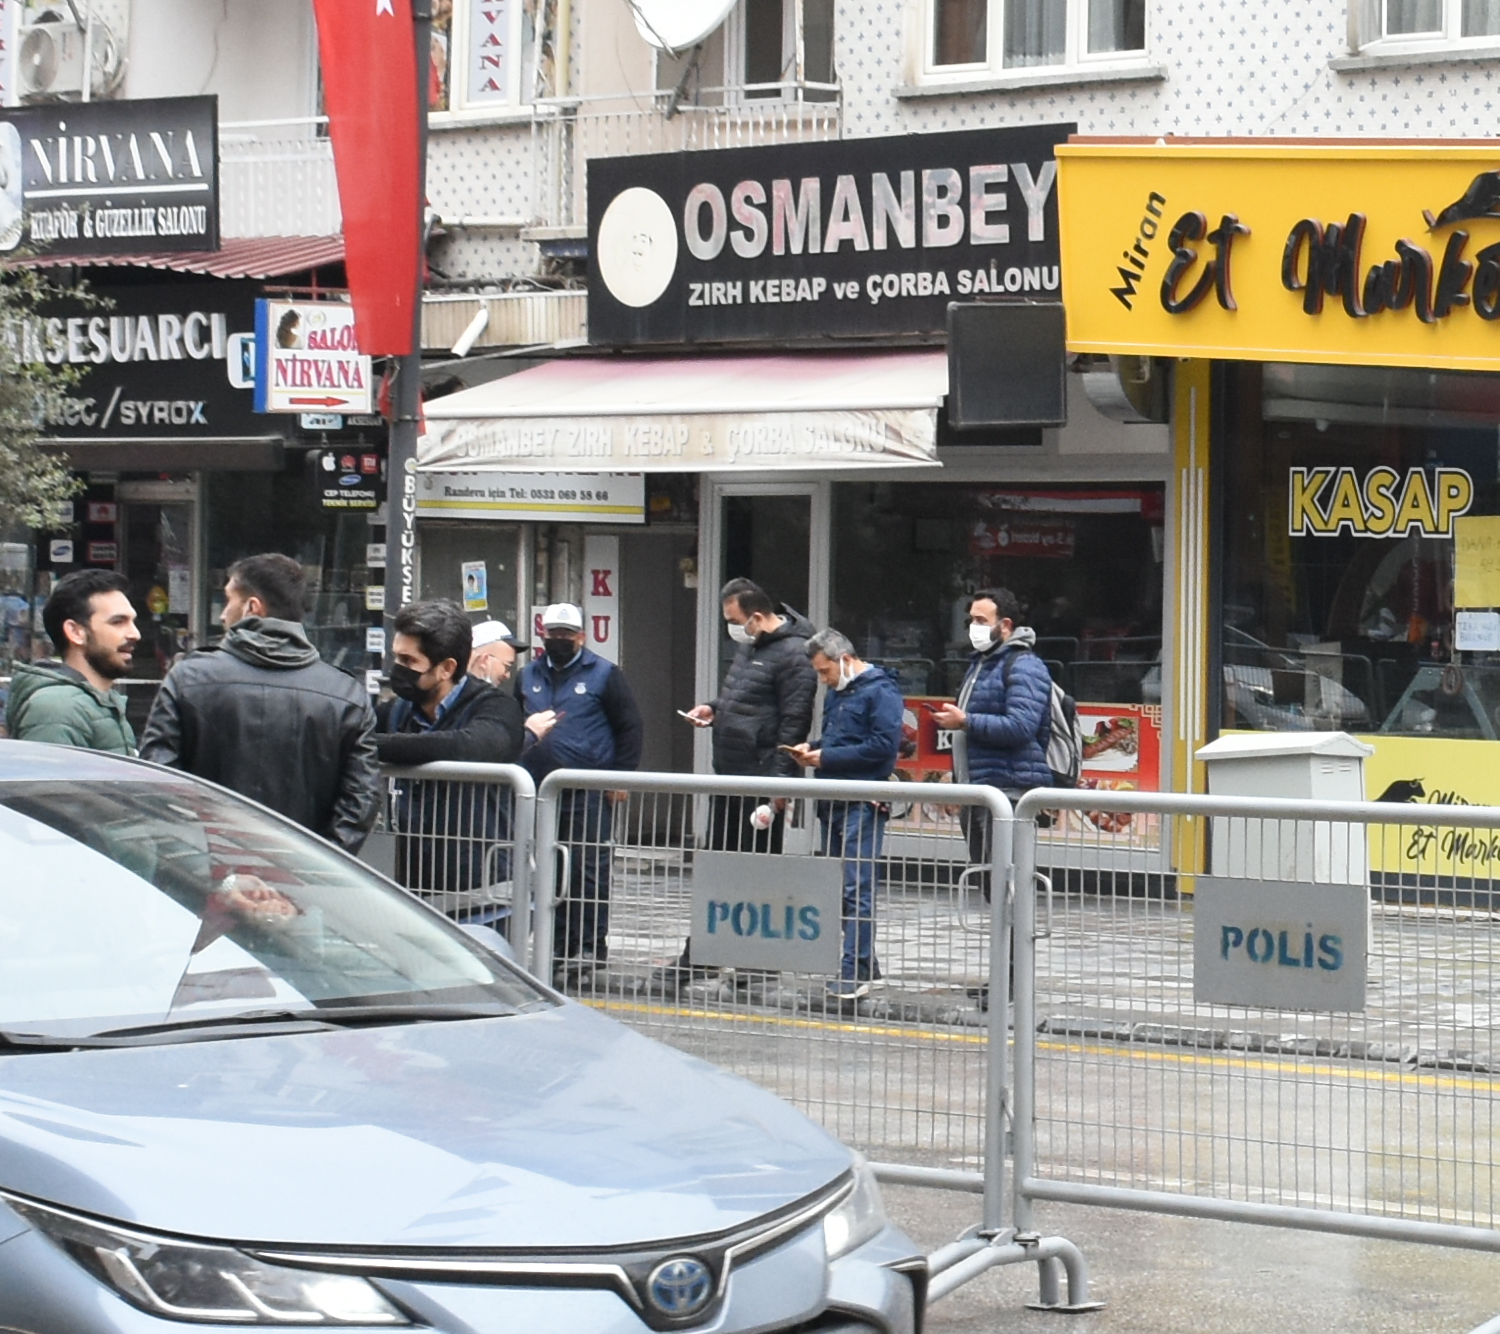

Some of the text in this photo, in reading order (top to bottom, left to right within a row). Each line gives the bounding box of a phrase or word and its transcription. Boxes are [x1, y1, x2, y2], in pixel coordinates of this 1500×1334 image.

[29, 120, 203, 185] NİRVANA
[83, 211, 93, 238] &
[95, 200, 156, 237] GÜZELLİK
[158, 205, 207, 236] SALONU
[684, 160, 1057, 261] OSMANBEY
[1108, 190, 1167, 312] Miran
[1159, 210, 1252, 316] Et
[688, 265, 1060, 307] ZIRH KEBAP ve ÇORBA SALONU
[275, 353, 365, 390] NİRVANA
[120, 400, 208, 425] SYROX
[568, 424, 613, 457] ZIRH
[625, 422, 690, 457] KEBAP
[700, 430, 715, 456] &
[728, 422, 797, 464] ÇORBA
[444, 486, 485, 499] Randevu
[488, 487, 506, 502] için
[509, 488, 528, 500] Tel:
[530, 489, 555, 501] 0532
[558, 490, 577, 501] 069
[1288, 466, 1474, 539] KASAP
[401, 475, 417, 608] BÜYÜKŞE
[1406, 828, 1436, 861] Et
[707, 895, 822, 942] POLİS
[1220, 922, 1345, 970] POLİS
